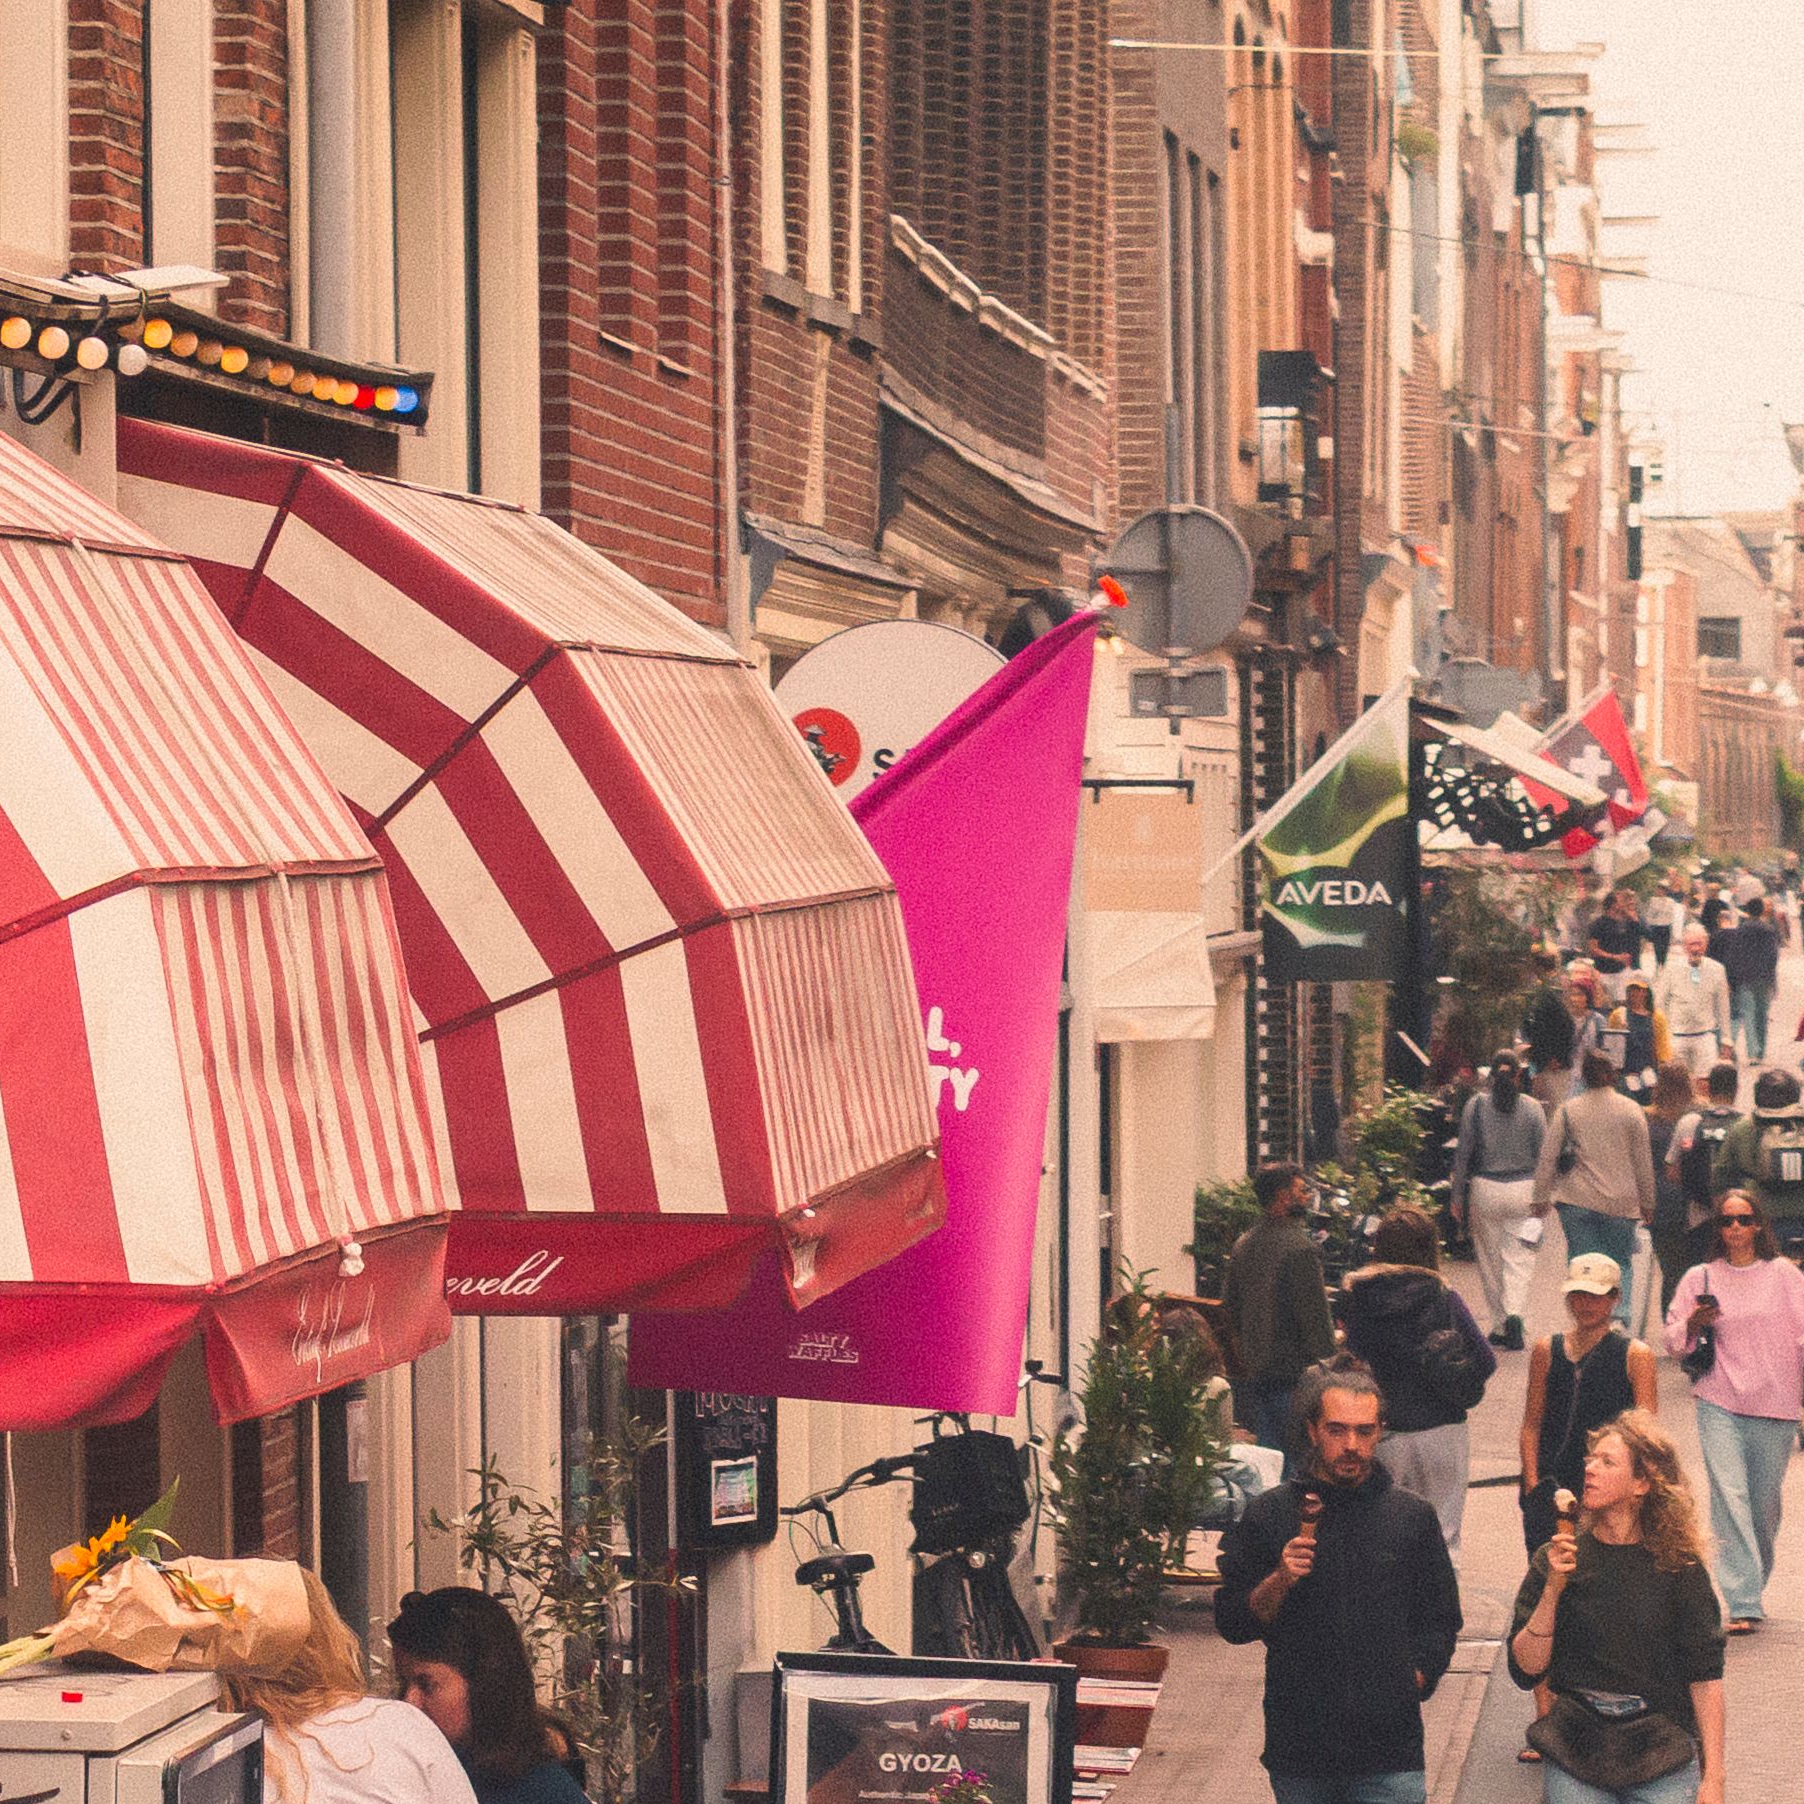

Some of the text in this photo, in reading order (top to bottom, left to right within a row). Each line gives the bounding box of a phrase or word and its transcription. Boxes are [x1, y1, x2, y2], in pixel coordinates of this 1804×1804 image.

[1276, 879, 1393, 906] AVEDA
[928, 1064, 980, 1112] TY
[447, 1249, 565, 1296] eveld
[878, 1752, 963, 1774] GYOZA
